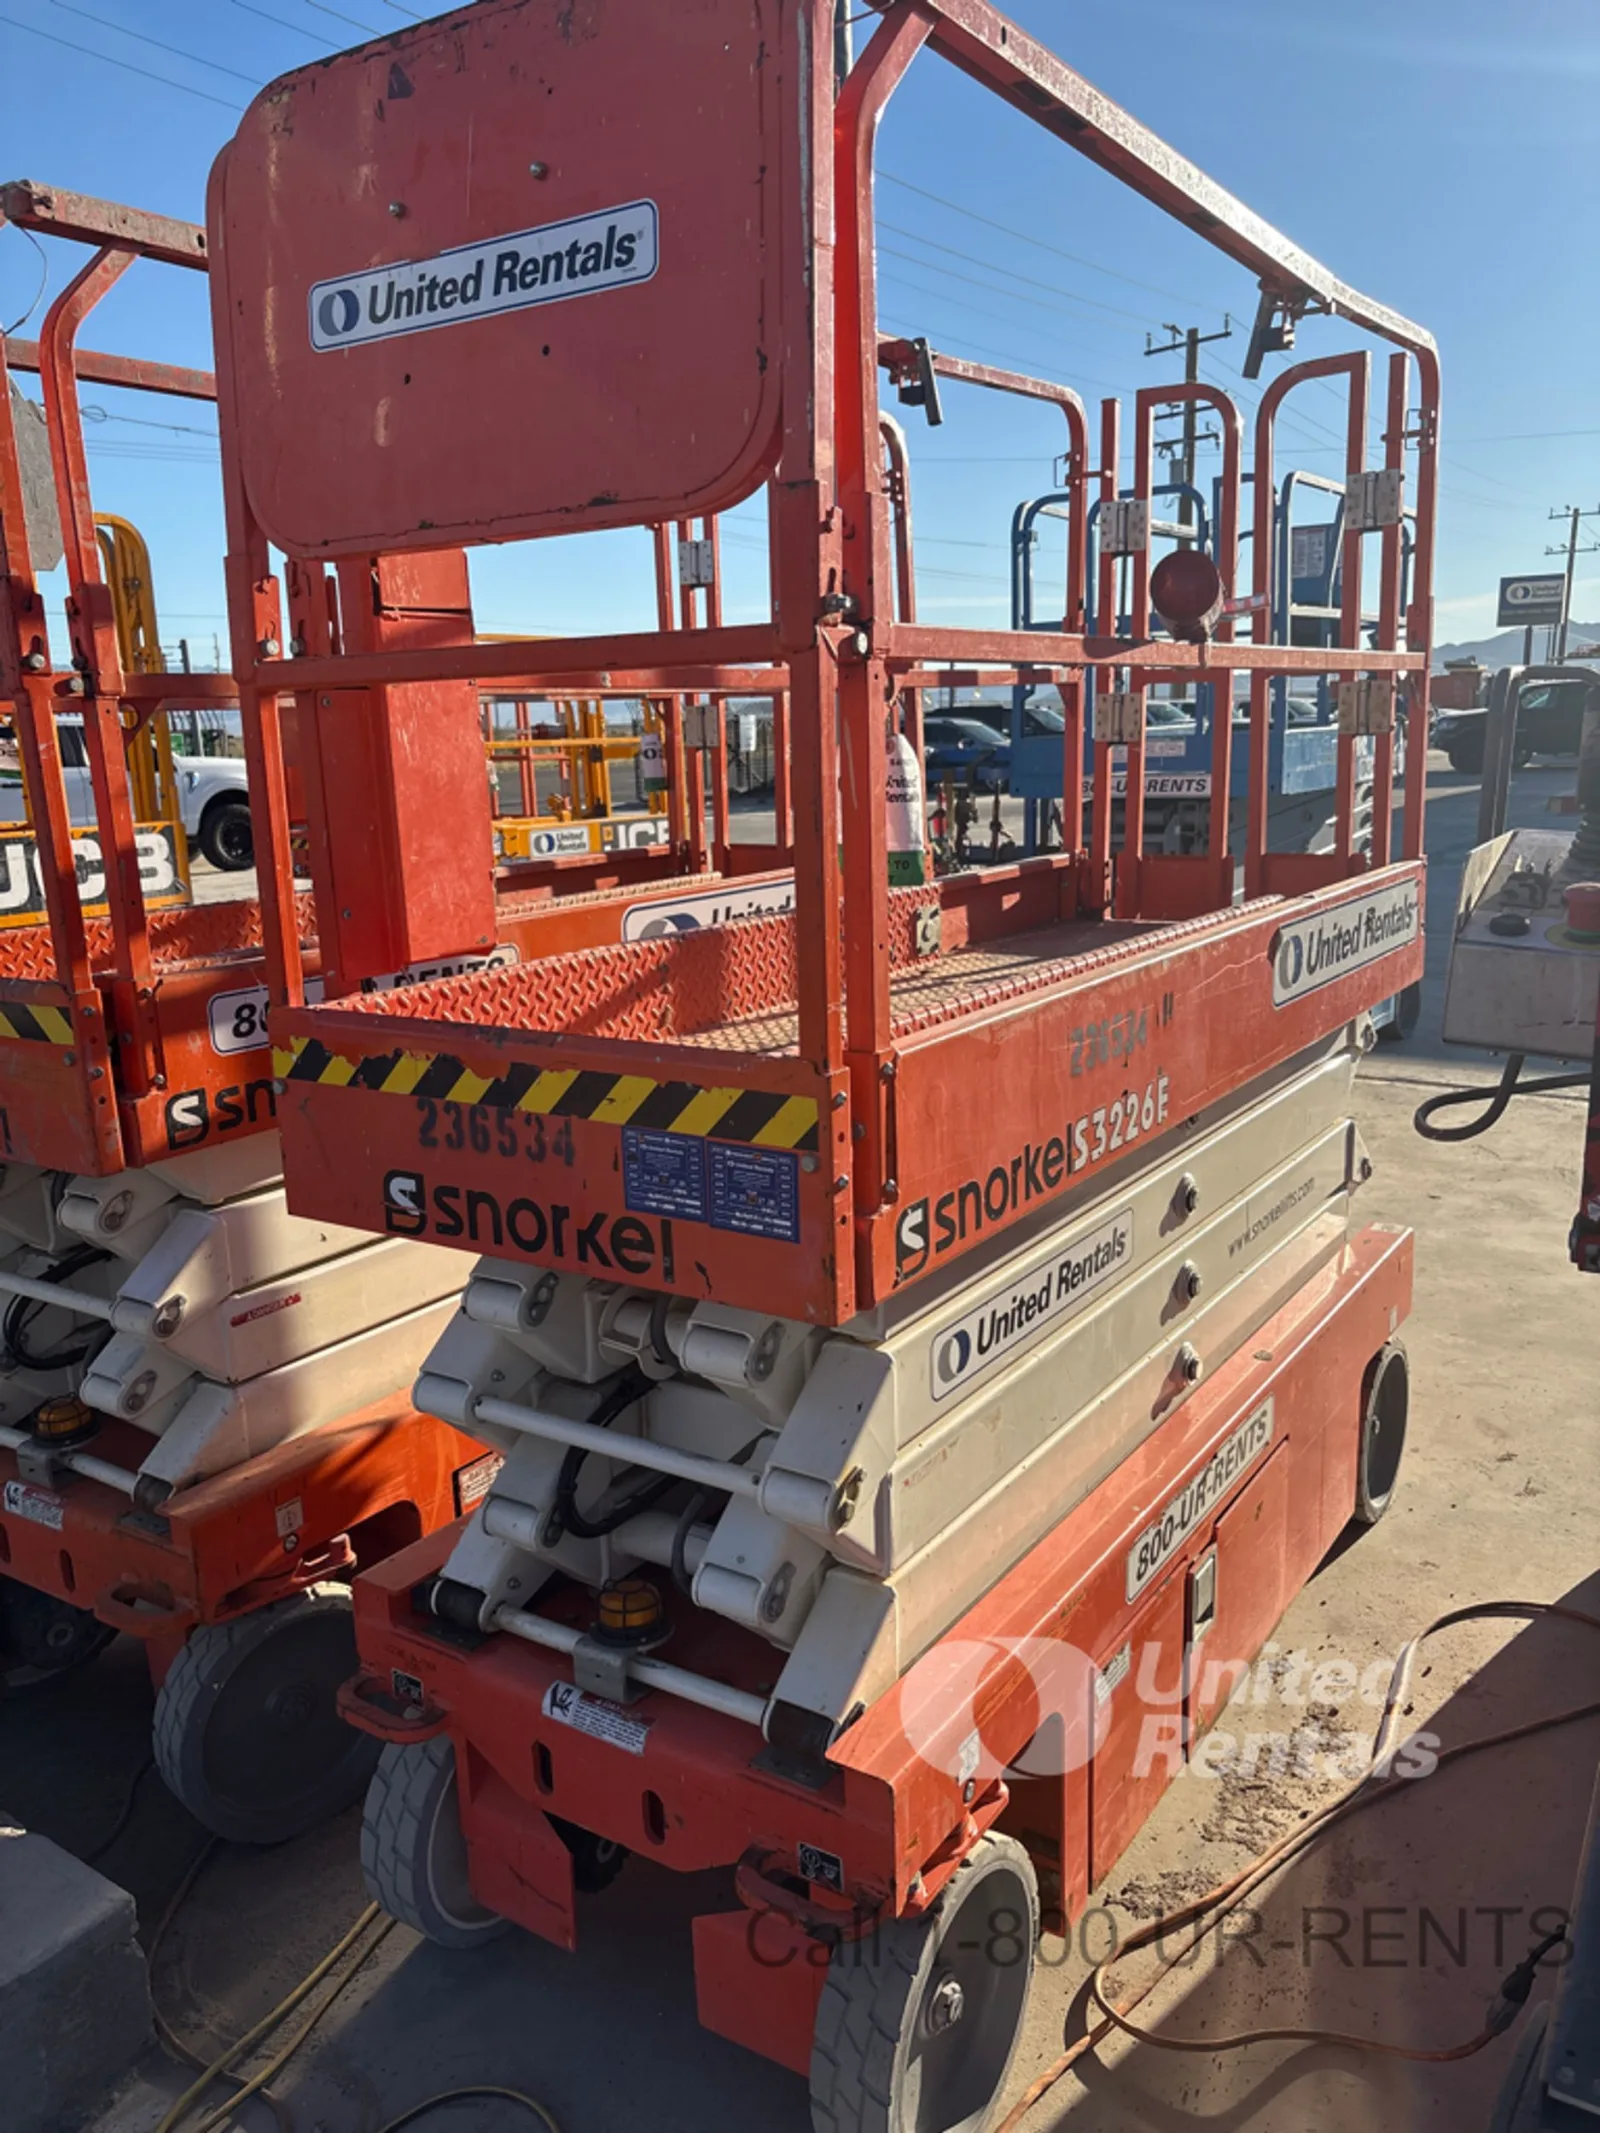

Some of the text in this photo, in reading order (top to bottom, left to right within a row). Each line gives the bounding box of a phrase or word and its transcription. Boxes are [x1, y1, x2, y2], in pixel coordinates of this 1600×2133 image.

[368, 225, 638, 325] United Rentals
[1306, 894, 1413, 976] United Rentals
[416, 1097, 576, 1167] 236534
[433, 1185, 675, 1284] snorkel
[935, 1123, 1073, 1256] snorkel
[977, 1226, 1127, 1356] United Rentals
[1136, 1414, 1267, 1582] 800-UR-RENTS
